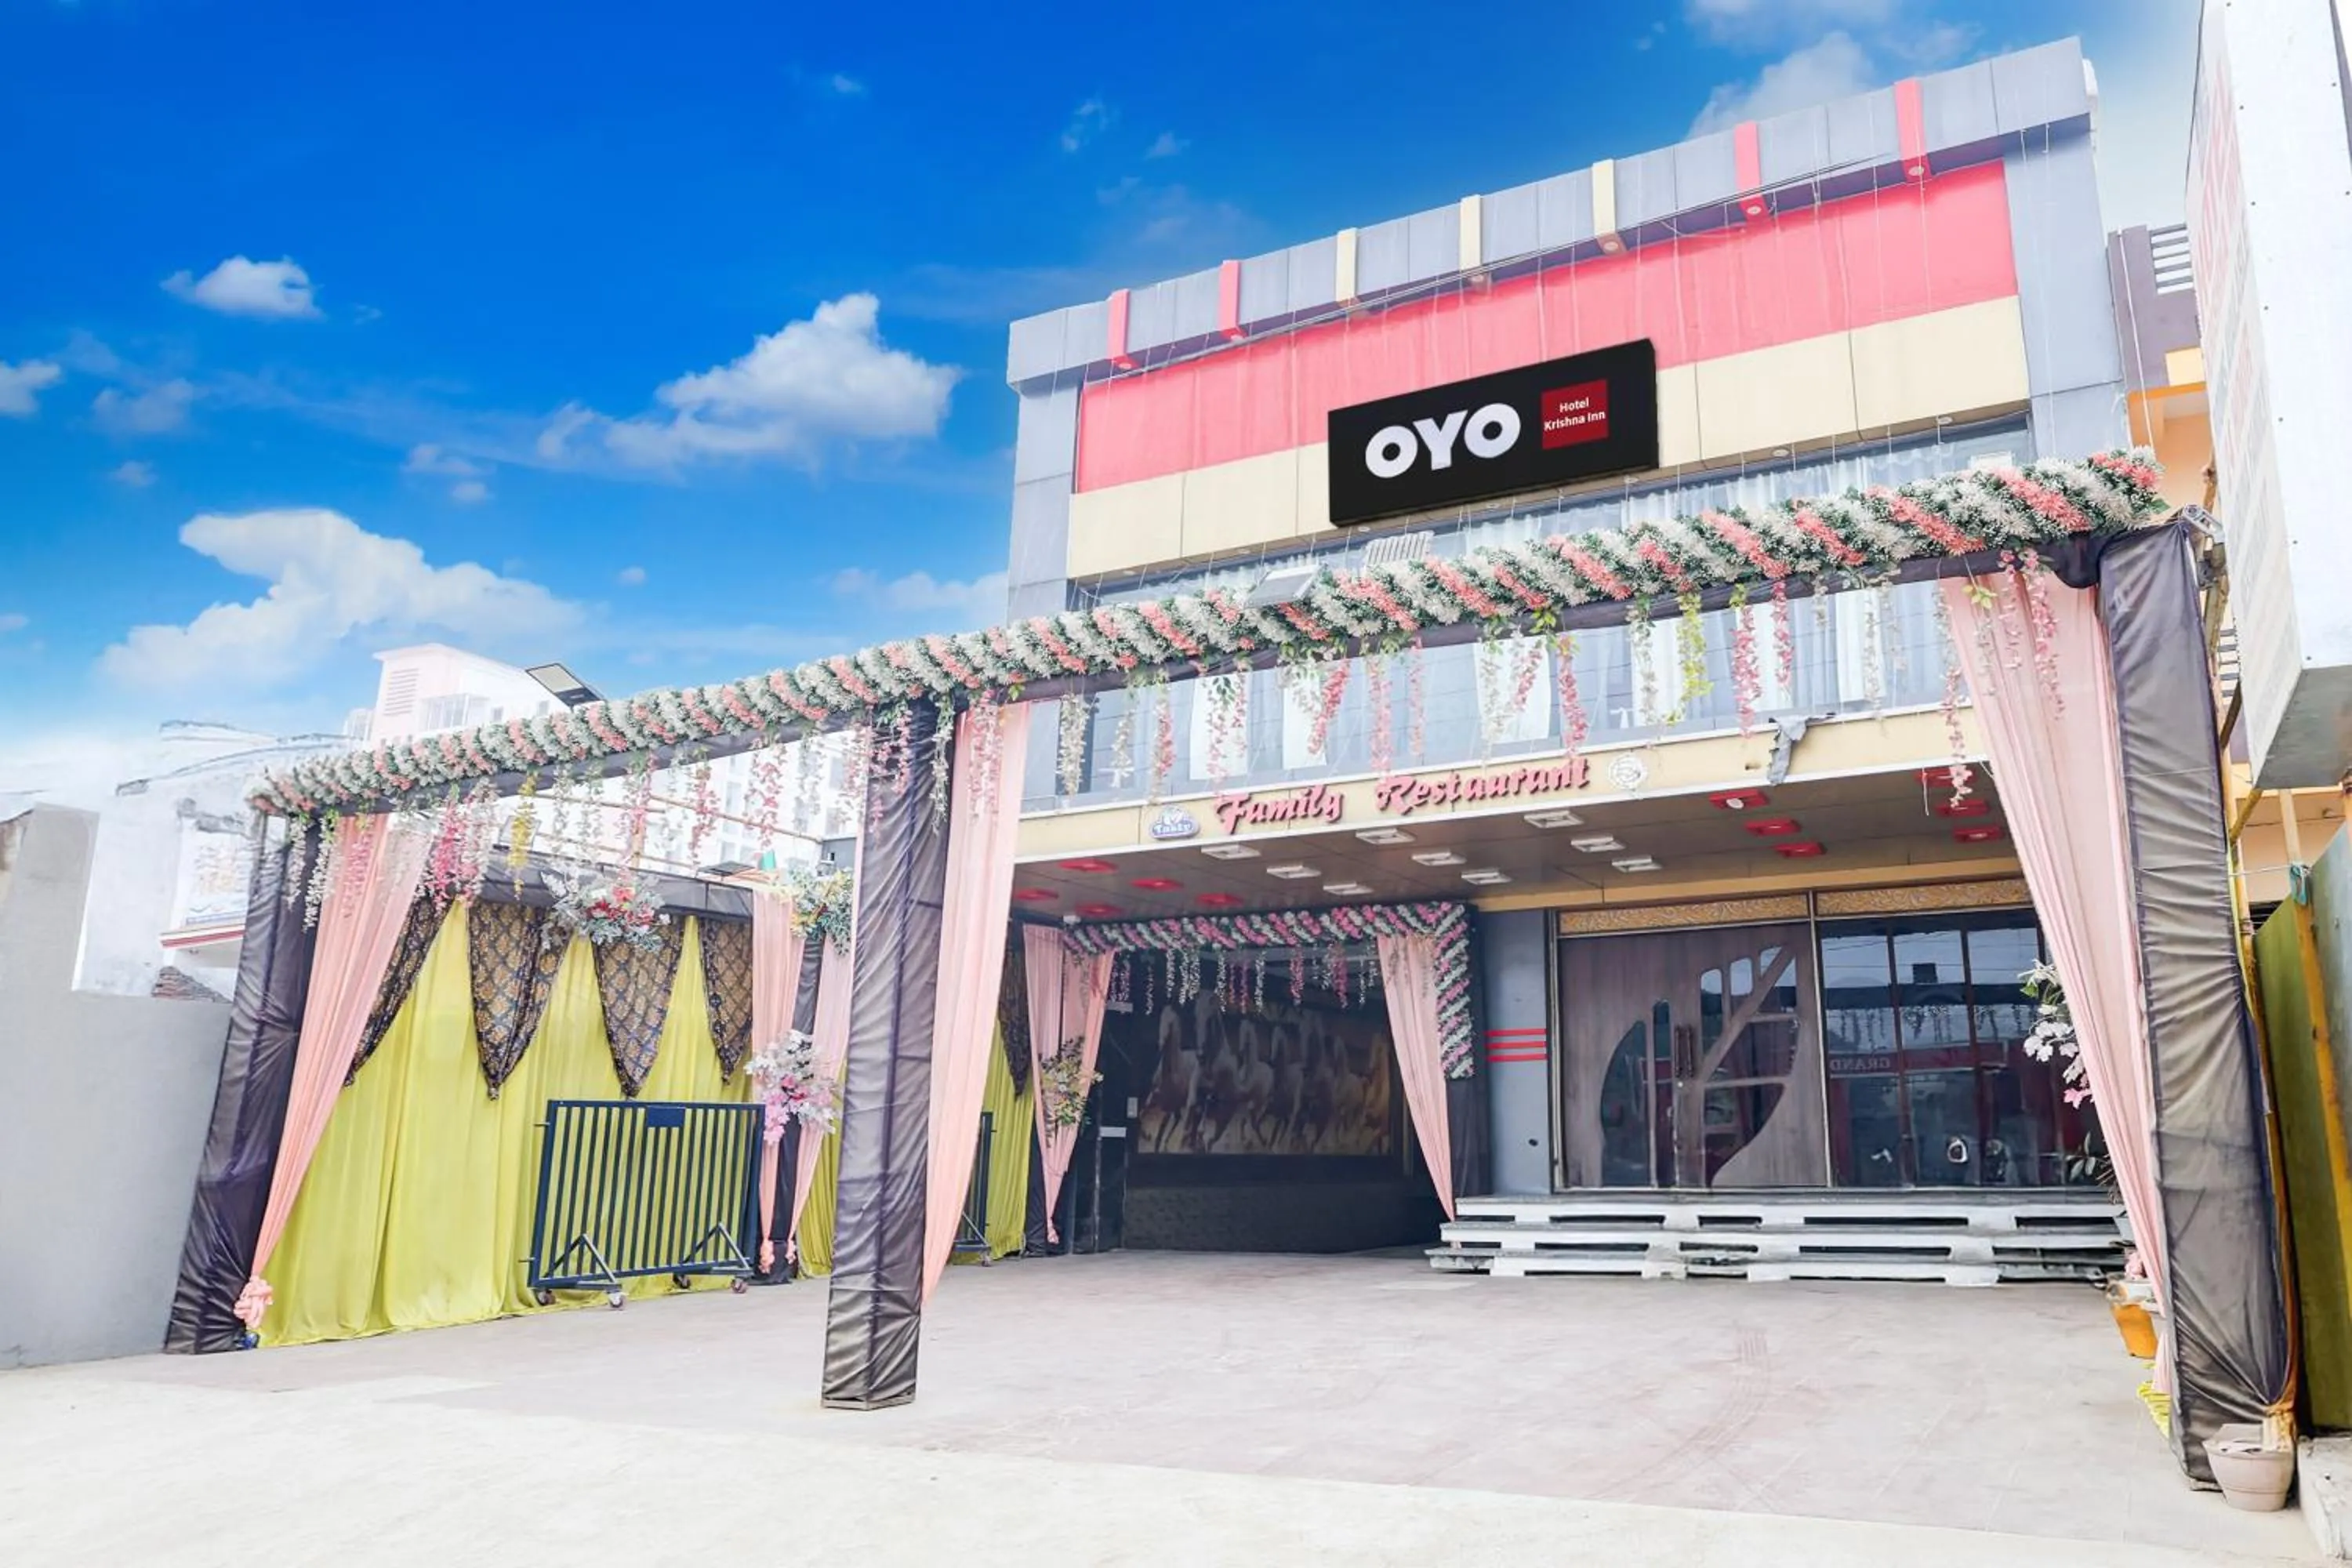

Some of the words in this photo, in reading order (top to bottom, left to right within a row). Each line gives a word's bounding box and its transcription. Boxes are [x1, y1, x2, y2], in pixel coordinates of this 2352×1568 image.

[1544, 416, 1585, 431] Krishna
[1588, 412, 1606, 422] Inn
[1559, 397, 1589, 412] Hotel
[1365, 403, 1521, 478] OYO
[1216, 785, 1344, 834] Family
[1376, 757, 1590, 815] Restaurant
